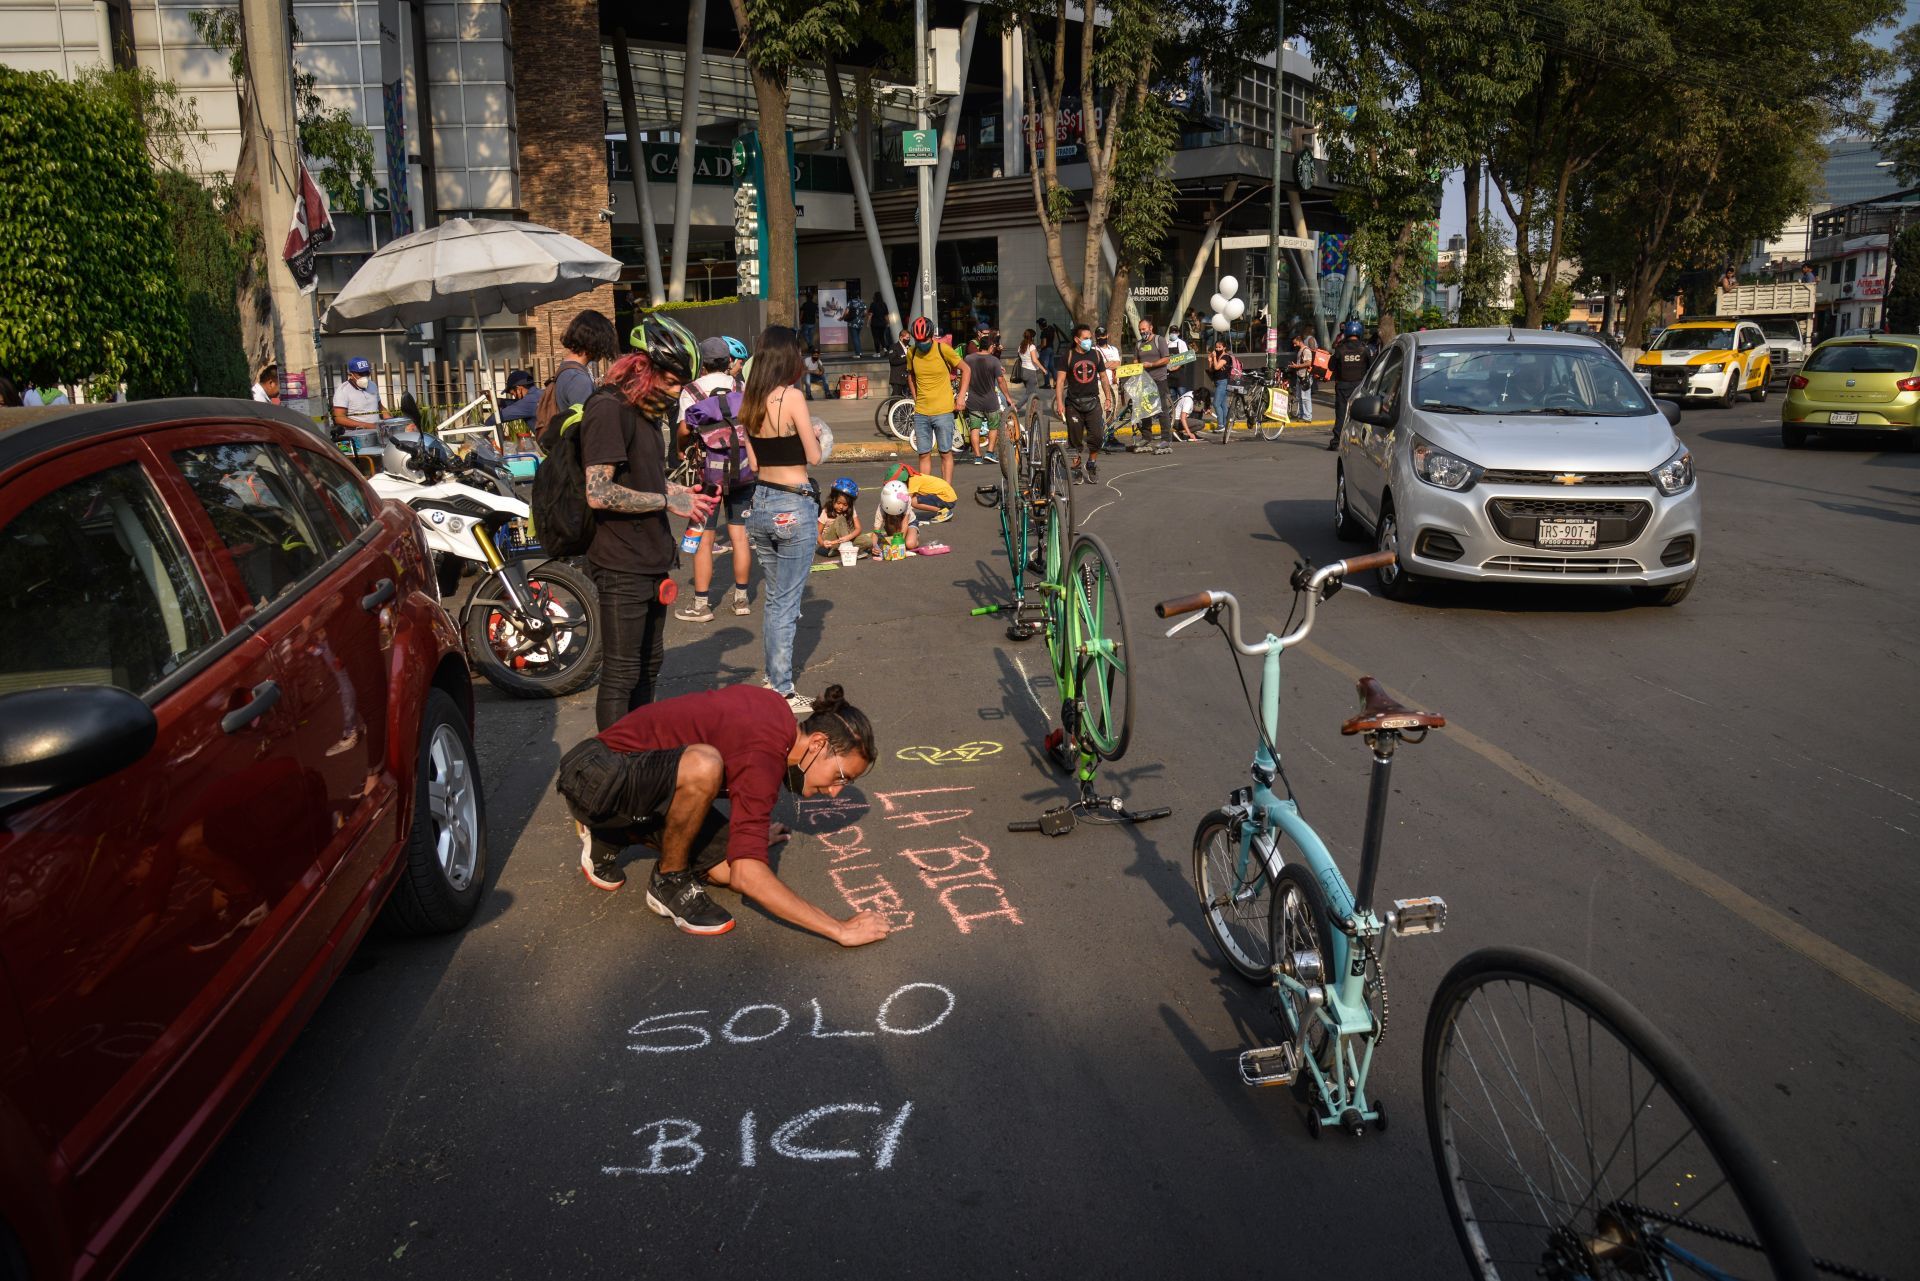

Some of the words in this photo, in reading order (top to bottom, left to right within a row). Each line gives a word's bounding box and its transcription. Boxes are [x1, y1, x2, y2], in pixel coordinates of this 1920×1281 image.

[1034, 108, 1070, 128] PIAS
[1071, 106, 1103, 132] $19
[651, 152, 711, 177] CAA
[1283, 239, 1308, 248] EGIPTO
[971, 265, 998, 275] ABRIMO
[1134, 286, 1168, 295] ABRIMOS
[1343, 354, 1361, 362] SSC
[1540, 525, 1596, 539] TRS-907-A
[873, 786, 976, 830] LA
[897, 834, 1024, 935] BICI
[626, 981, 956, 1053] SOLO
[601, 1100, 915, 1176] BICI
